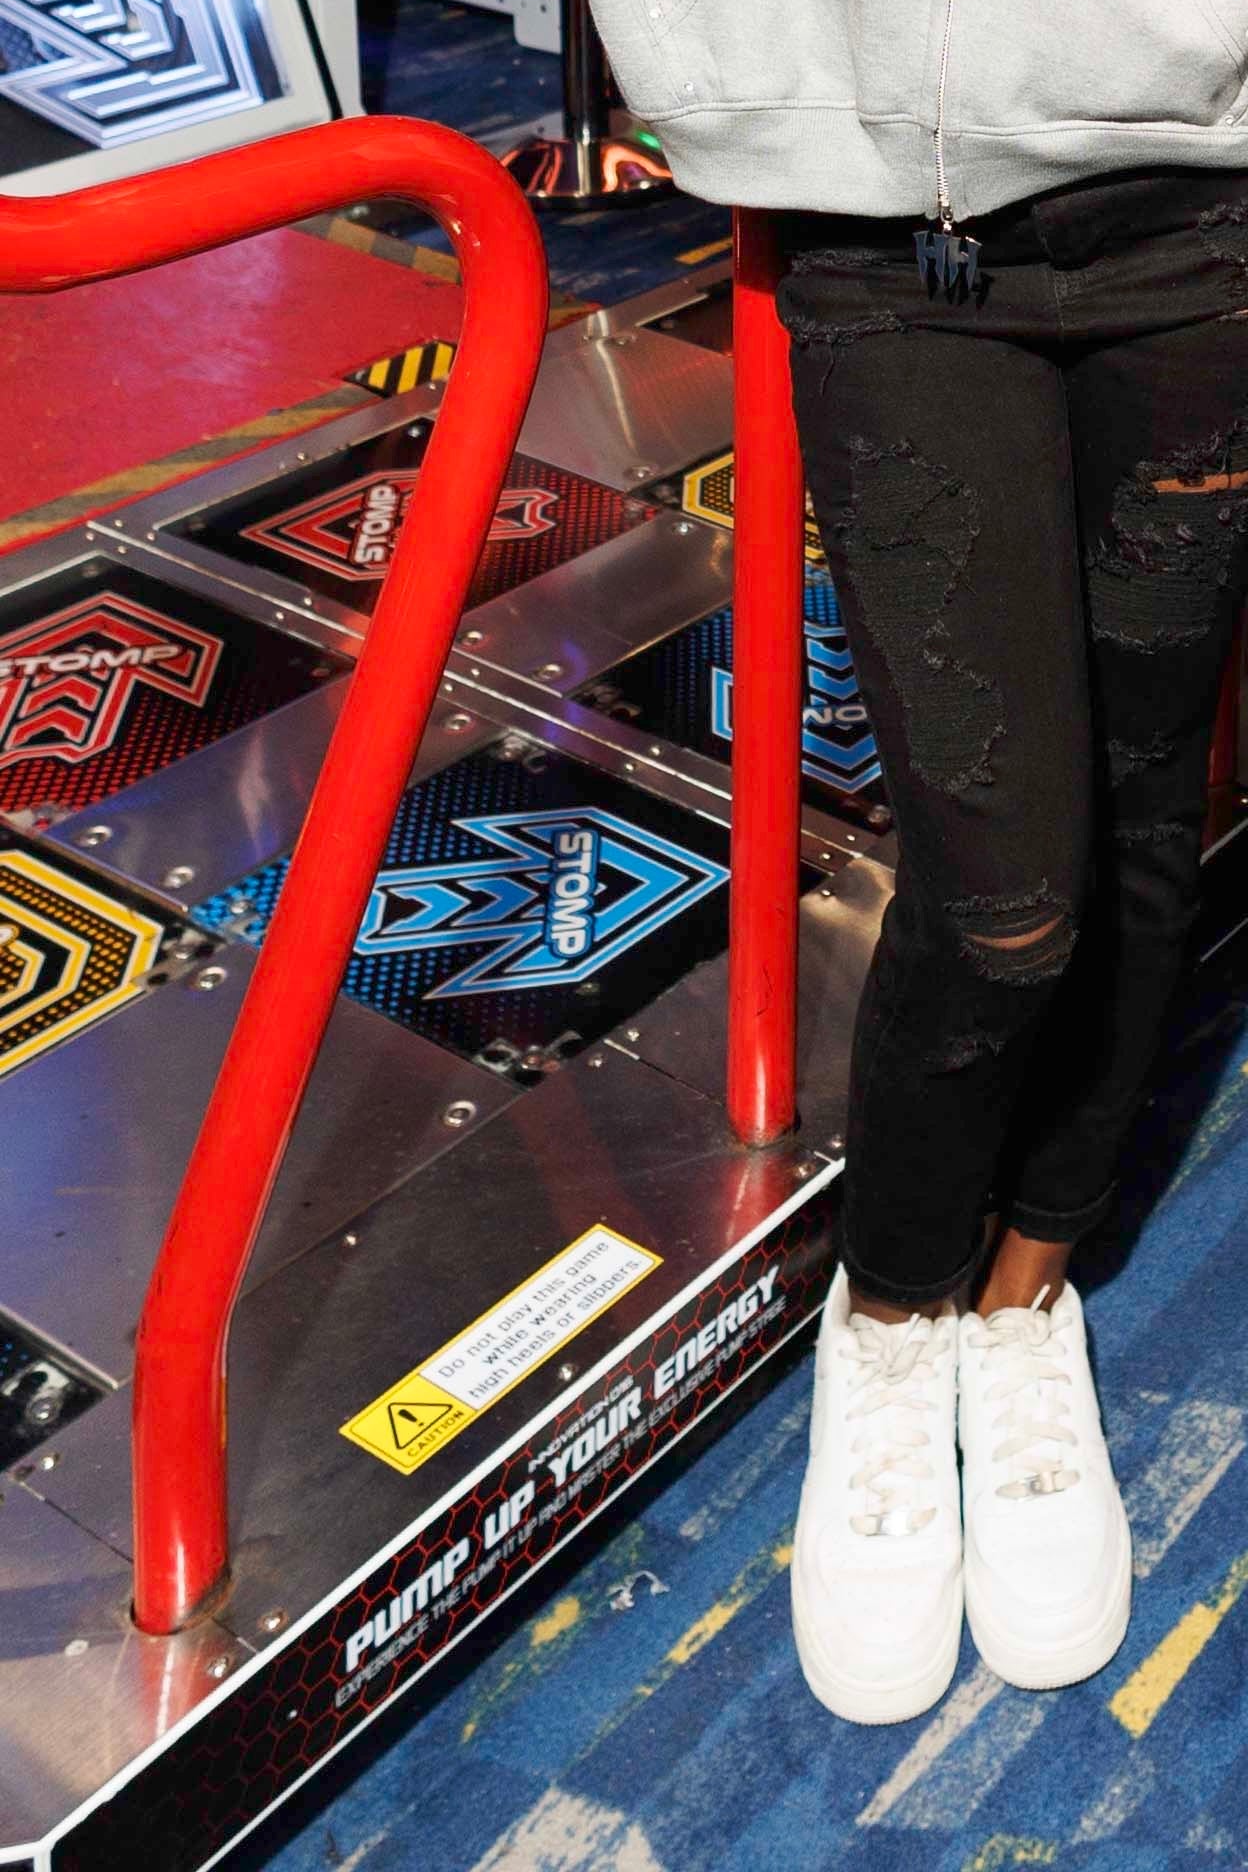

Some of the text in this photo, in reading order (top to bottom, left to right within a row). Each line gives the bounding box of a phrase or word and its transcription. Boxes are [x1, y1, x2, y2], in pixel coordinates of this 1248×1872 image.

[354, 485, 397, 564] STOMP
[551, 832, 593, 955] STOMP
[438, 1242, 609, 1378] Do not play this game
[482, 1273, 597, 1366] while wearing
[468, 1368, 509, 1399] high
[507, 1330, 556, 1367] heels
[345, 1264, 780, 1673] PUMP UP YOUR ENERGY
[407, 1409, 465, 1459] CAUTION
